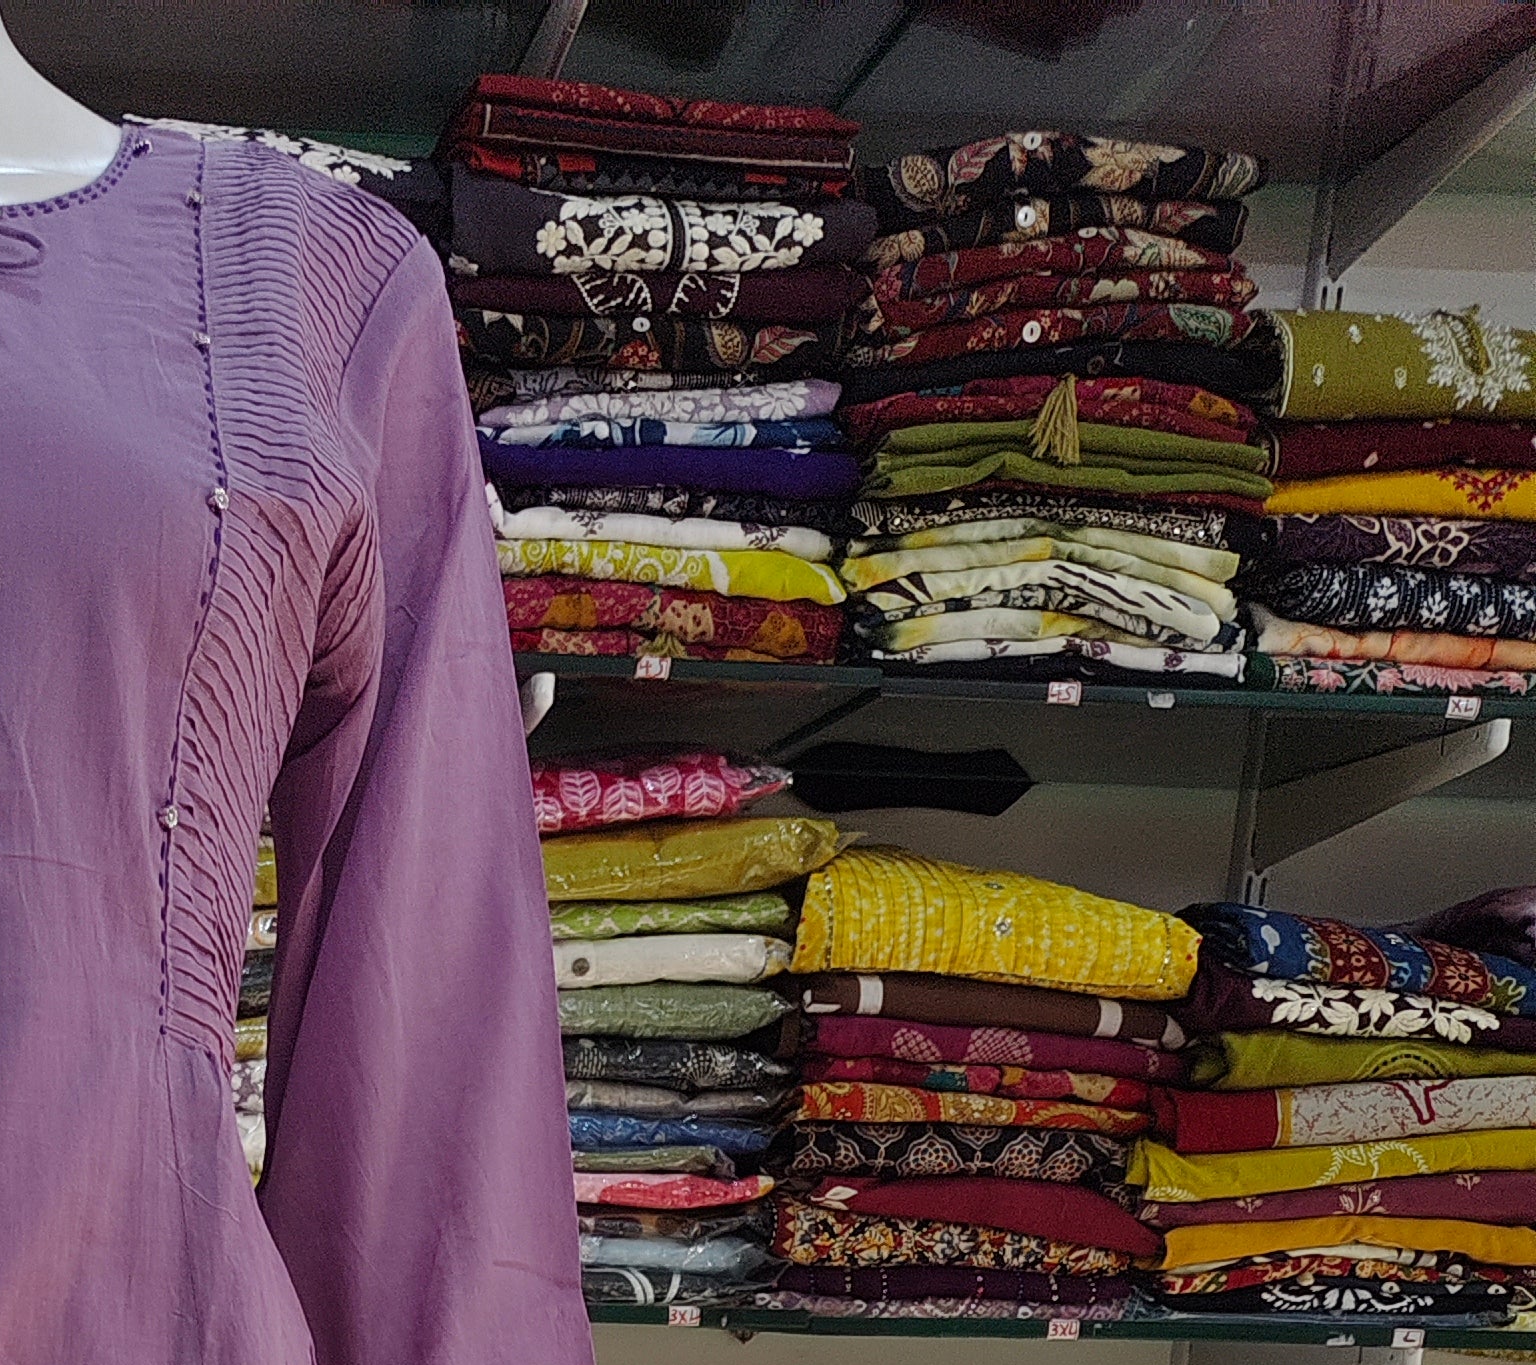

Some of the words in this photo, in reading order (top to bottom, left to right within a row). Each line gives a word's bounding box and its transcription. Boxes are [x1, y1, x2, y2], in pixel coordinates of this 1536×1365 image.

[1452, 699, 1473, 713] XL
[671, 1310, 701, 1324] 3XL
[1052, 1324, 1078, 1336] 3XL
[1404, 1331, 1416, 1342] L
